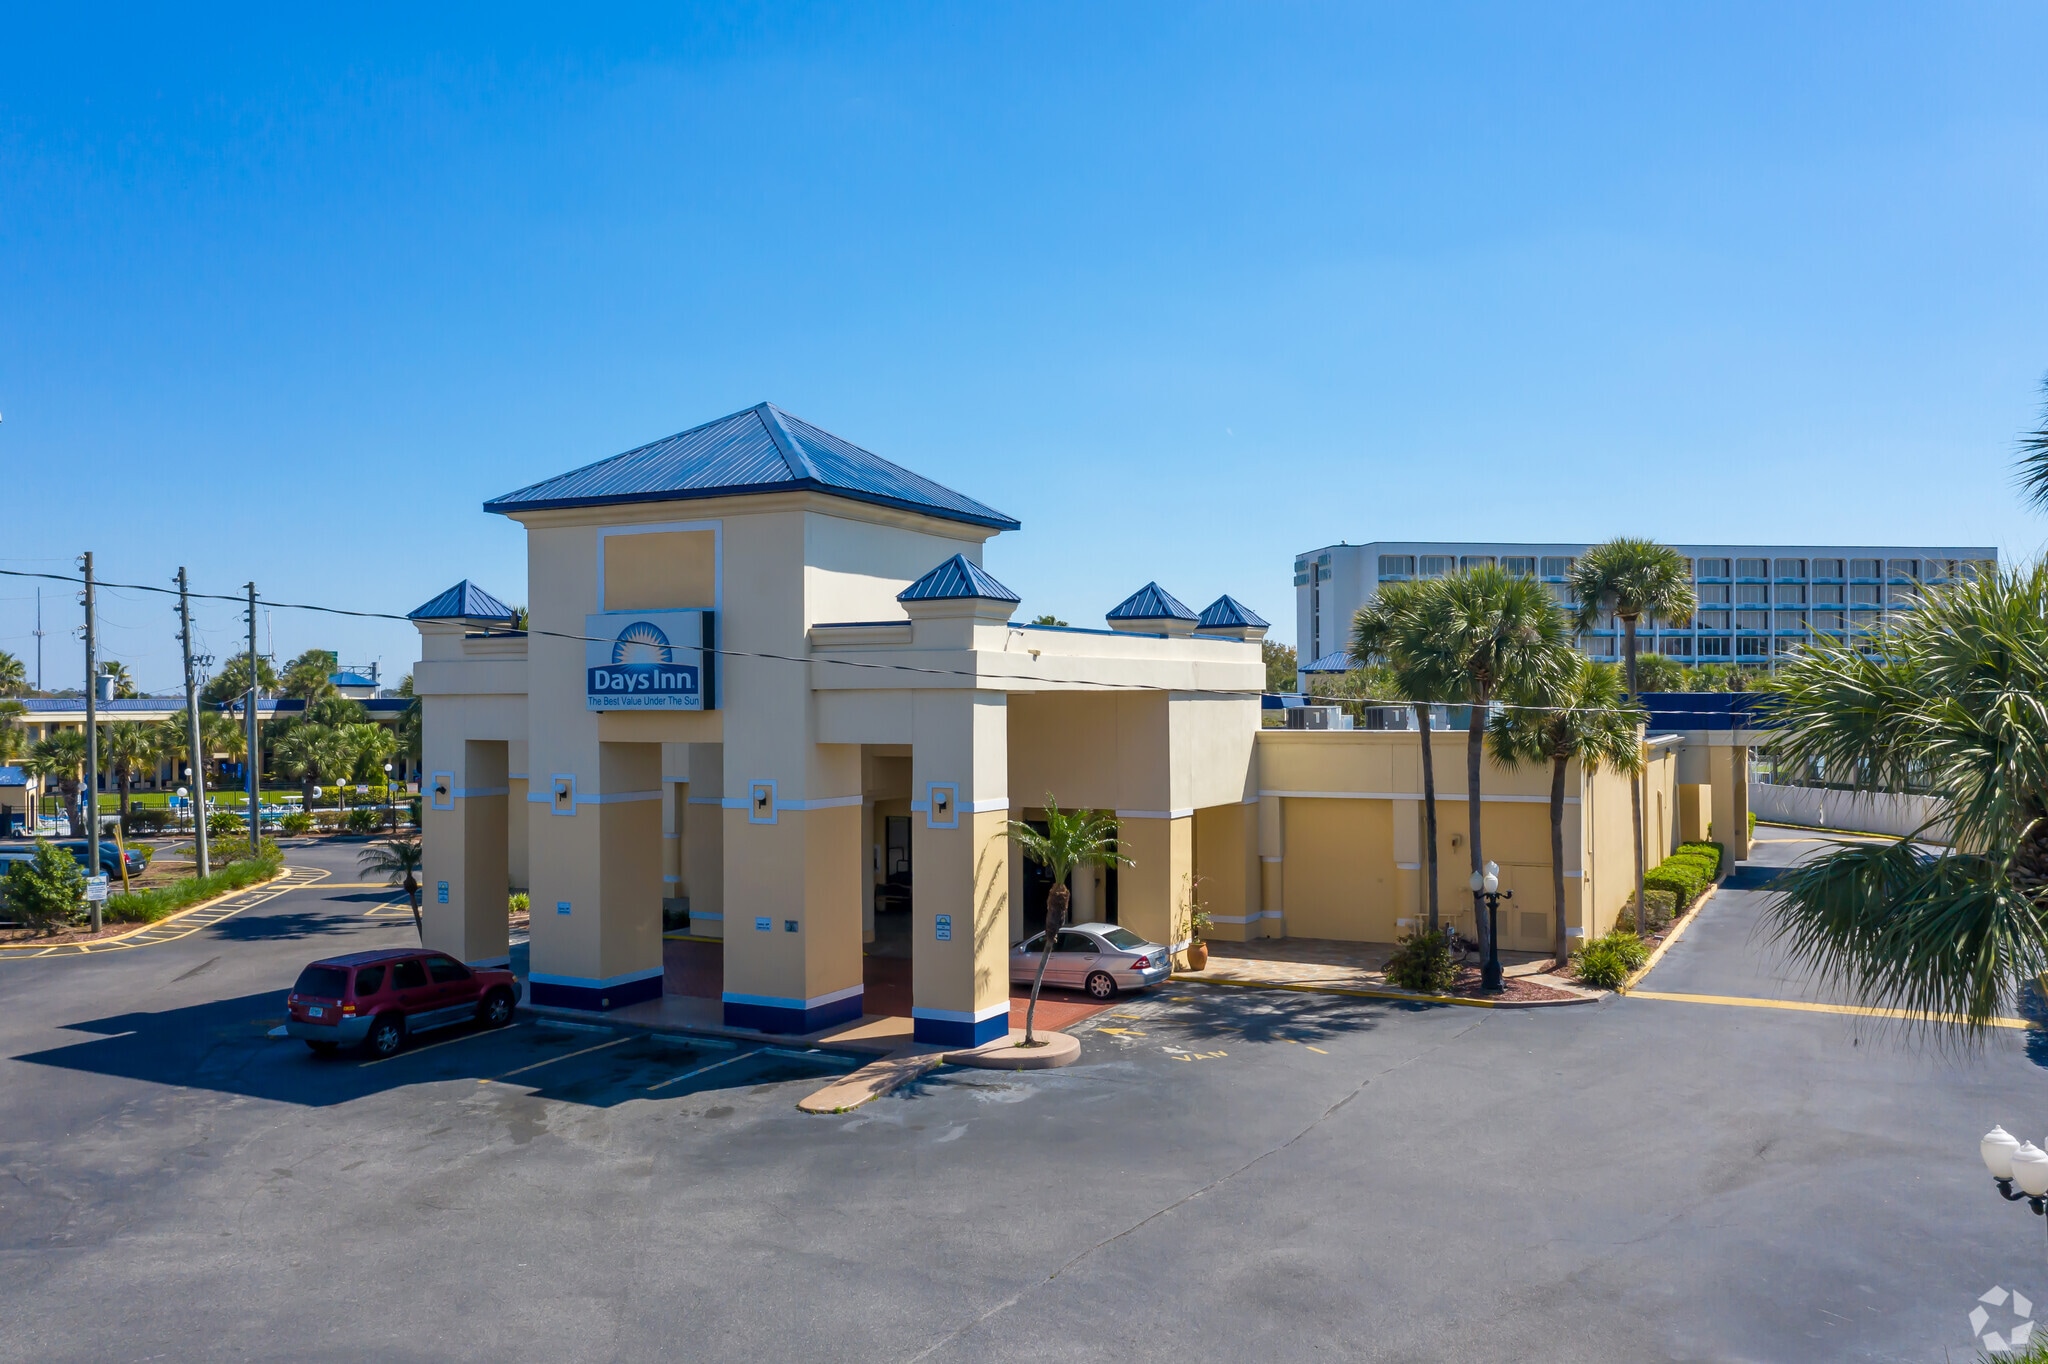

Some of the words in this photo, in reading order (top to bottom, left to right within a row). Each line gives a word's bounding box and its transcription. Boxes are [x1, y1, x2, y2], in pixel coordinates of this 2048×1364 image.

[594, 670, 649, 692] Days
[653, 669, 692, 689] Inn
[588, 696, 602, 706] The
[603, 696, 620, 706] Best
[621, 696, 642, 705] Value
[643, 696, 666, 705] Under
[667, 696, 683, 705] The
[684, 695, 699, 705] Sun
[1171, 1050, 1229, 1062] VAN
